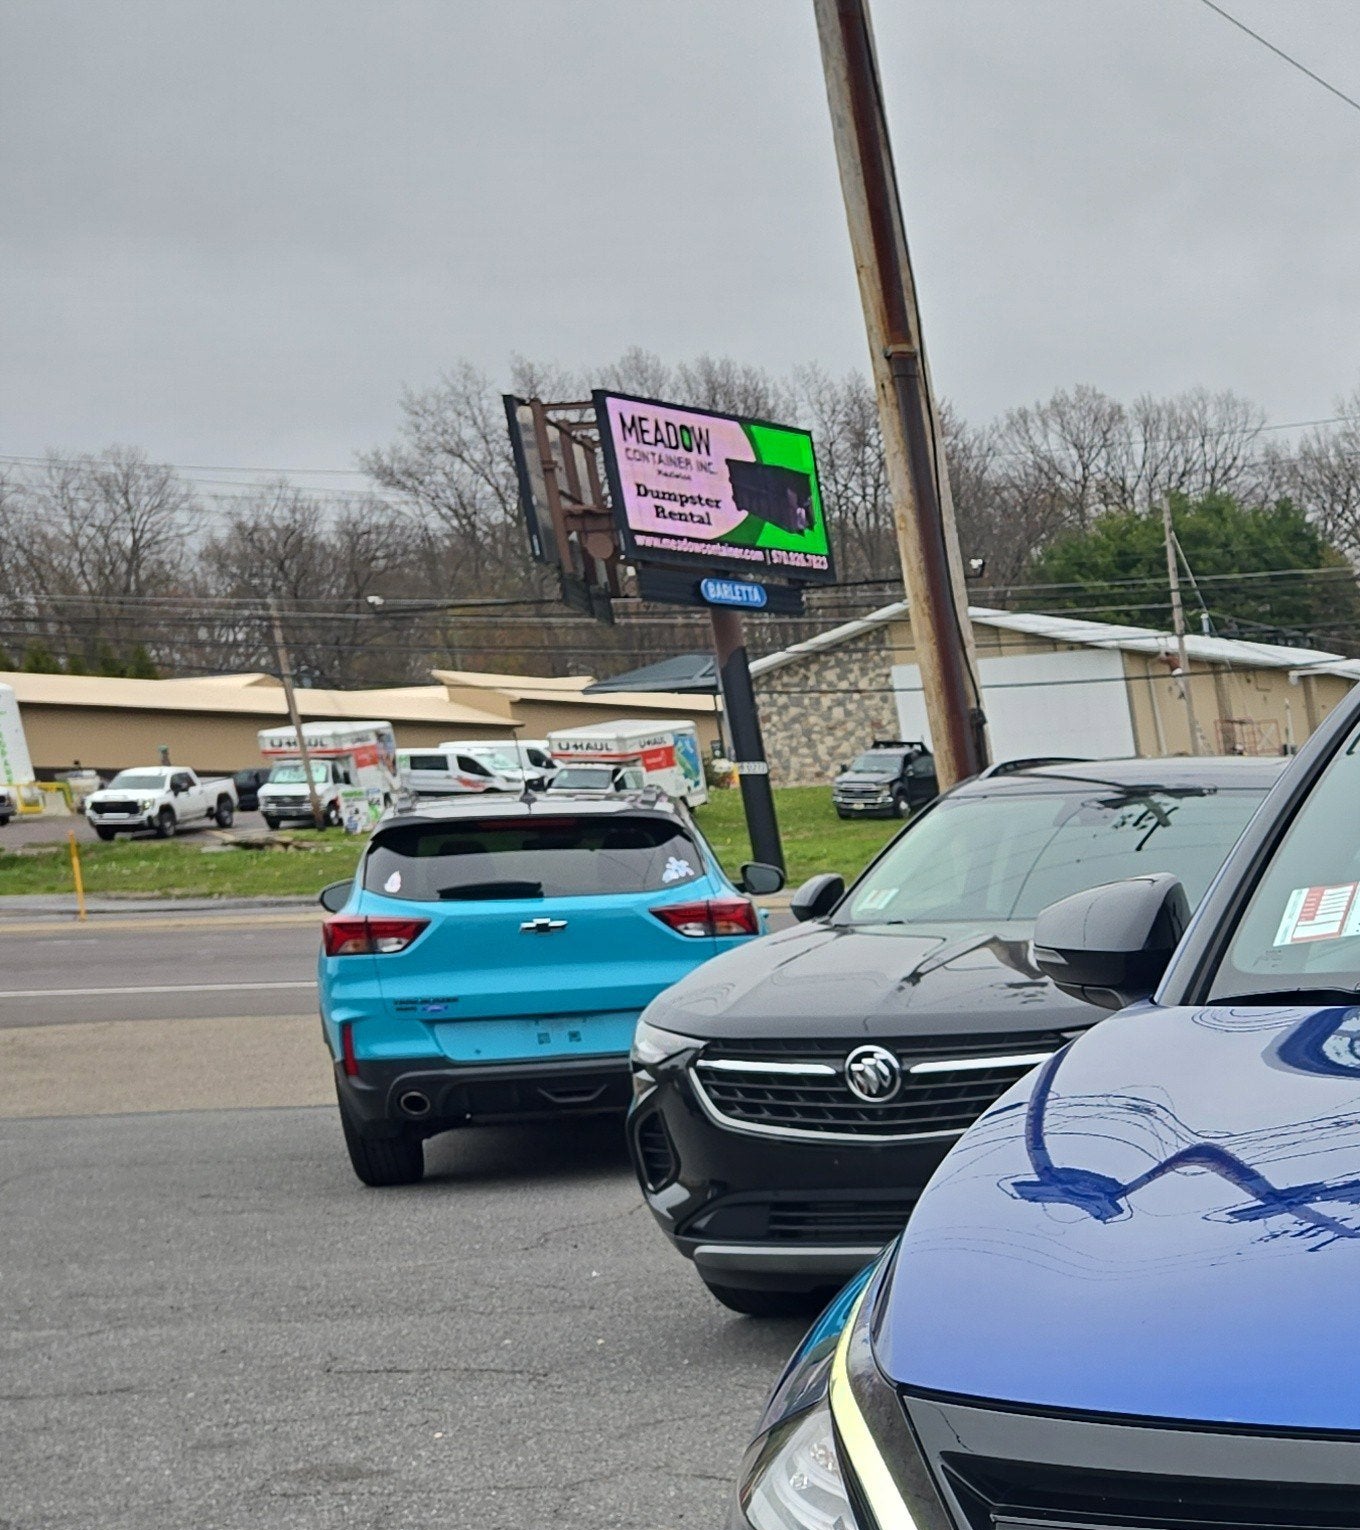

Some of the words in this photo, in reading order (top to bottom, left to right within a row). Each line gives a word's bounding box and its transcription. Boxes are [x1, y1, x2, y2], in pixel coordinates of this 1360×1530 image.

[619, 411, 711, 456] MEADOW
[635, 482, 722, 509] Dumpster
[654, 504, 712, 526] Rental
